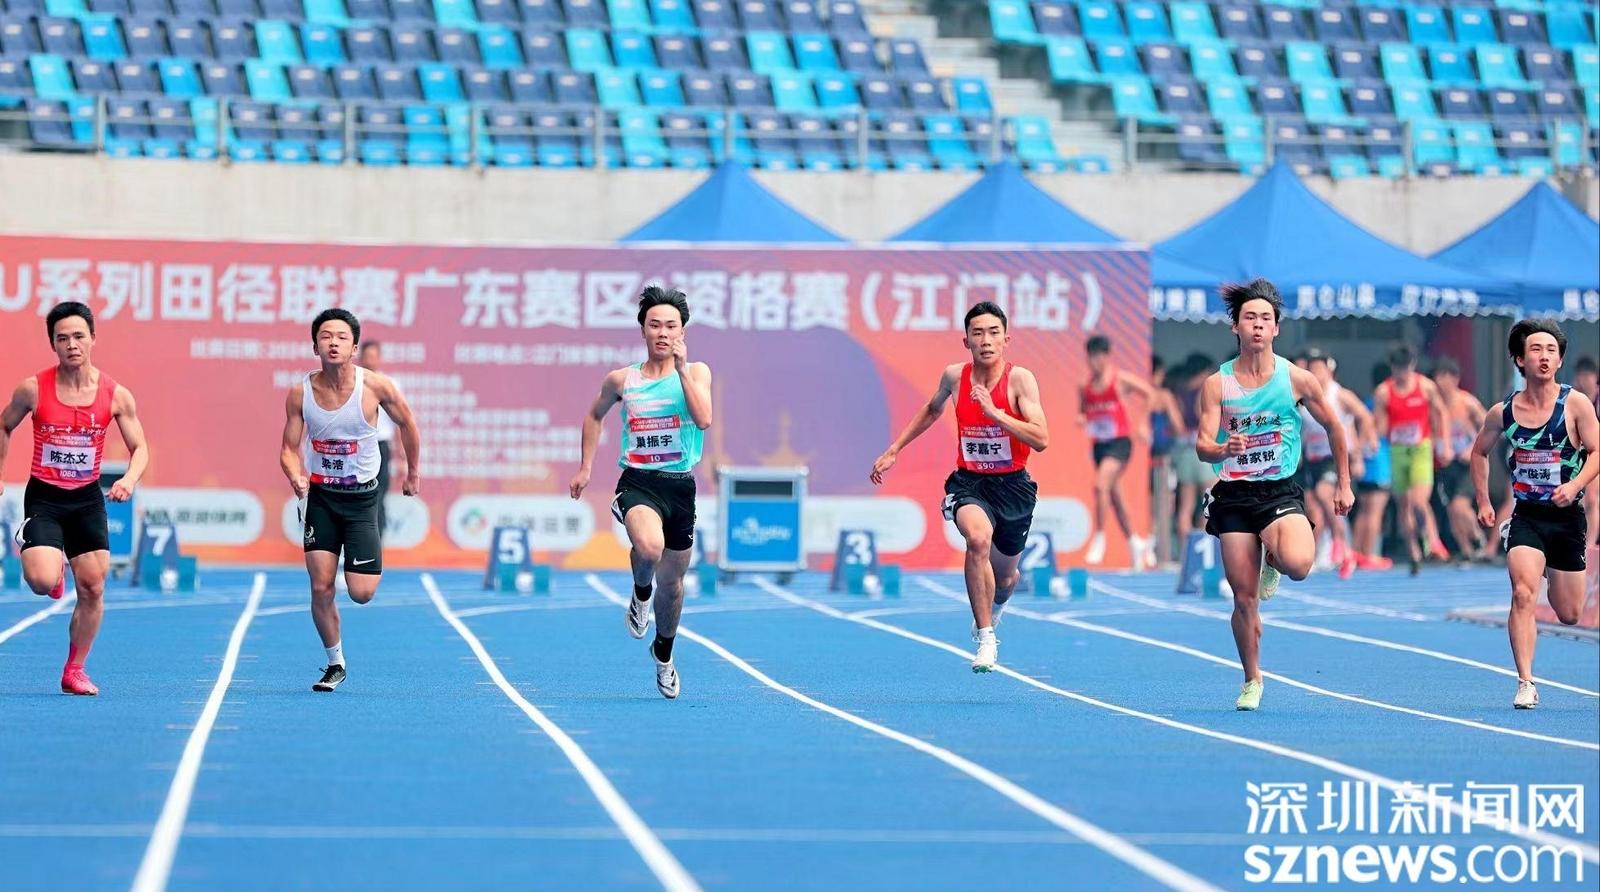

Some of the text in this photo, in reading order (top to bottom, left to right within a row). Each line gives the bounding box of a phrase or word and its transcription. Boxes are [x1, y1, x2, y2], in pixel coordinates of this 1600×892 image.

[636, 434, 673, 448] 巢振宇
[966, 442, 1002, 455] 李嘉宁
[50, 450, 88, 465] 陈杰文
[323, 476, 341, 484] 673
[146, 527, 173, 556] 7
[498, 529, 524, 564] 5
[845, 533, 872, 565] 3
[1022, 534, 1050, 569] 2
[1194, 536, 1215, 569] 1
